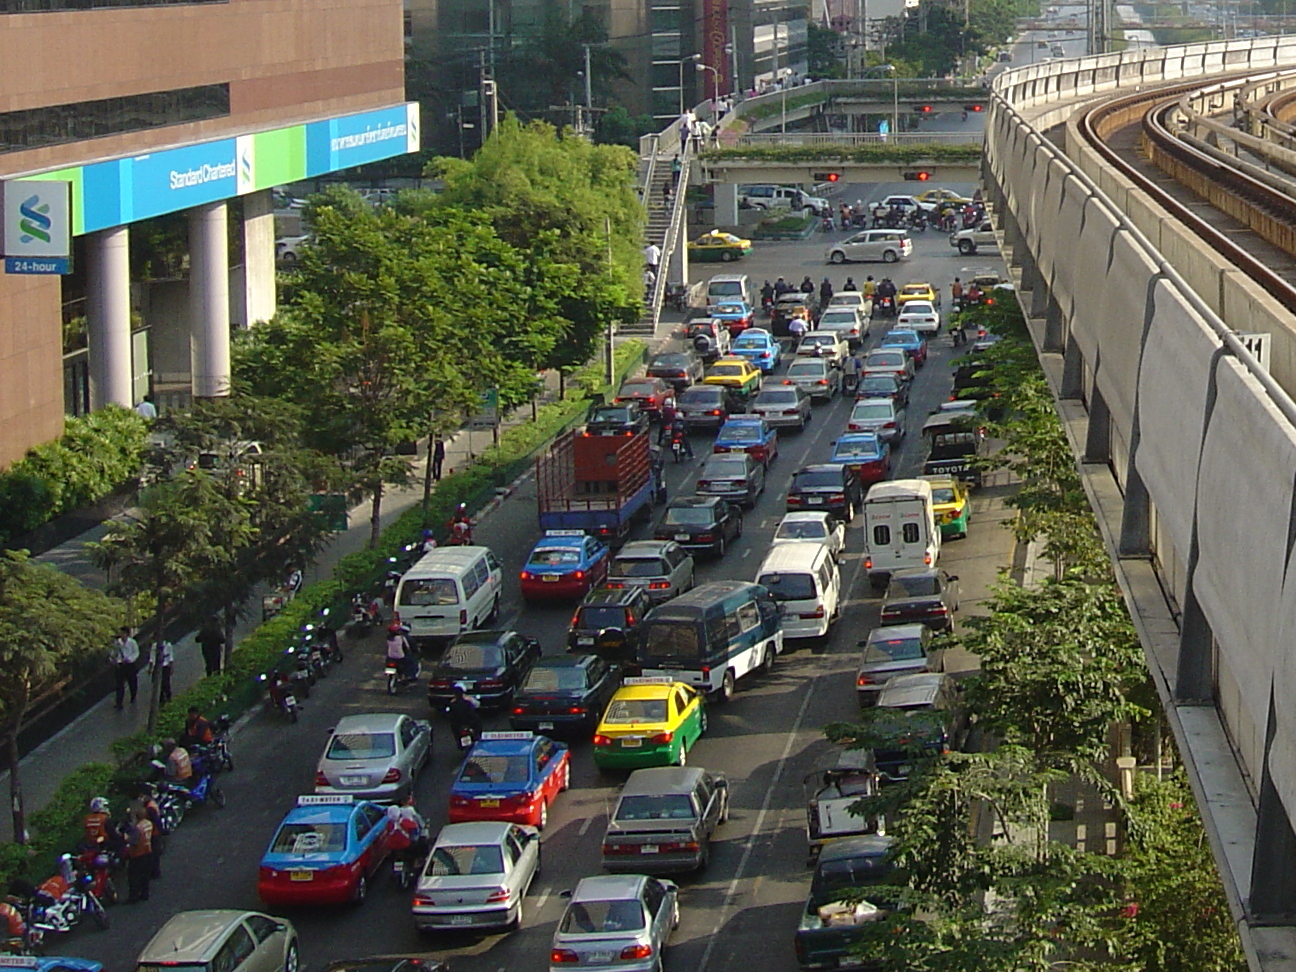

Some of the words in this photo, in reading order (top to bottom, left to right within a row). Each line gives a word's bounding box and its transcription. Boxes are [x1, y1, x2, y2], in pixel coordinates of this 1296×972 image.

[170, 166, 202, 189] Standard
[203, 159, 235, 182] Chartered
[15, 261, 57, 271] 24-hour
[932, 465, 969, 474] TOYOTA
